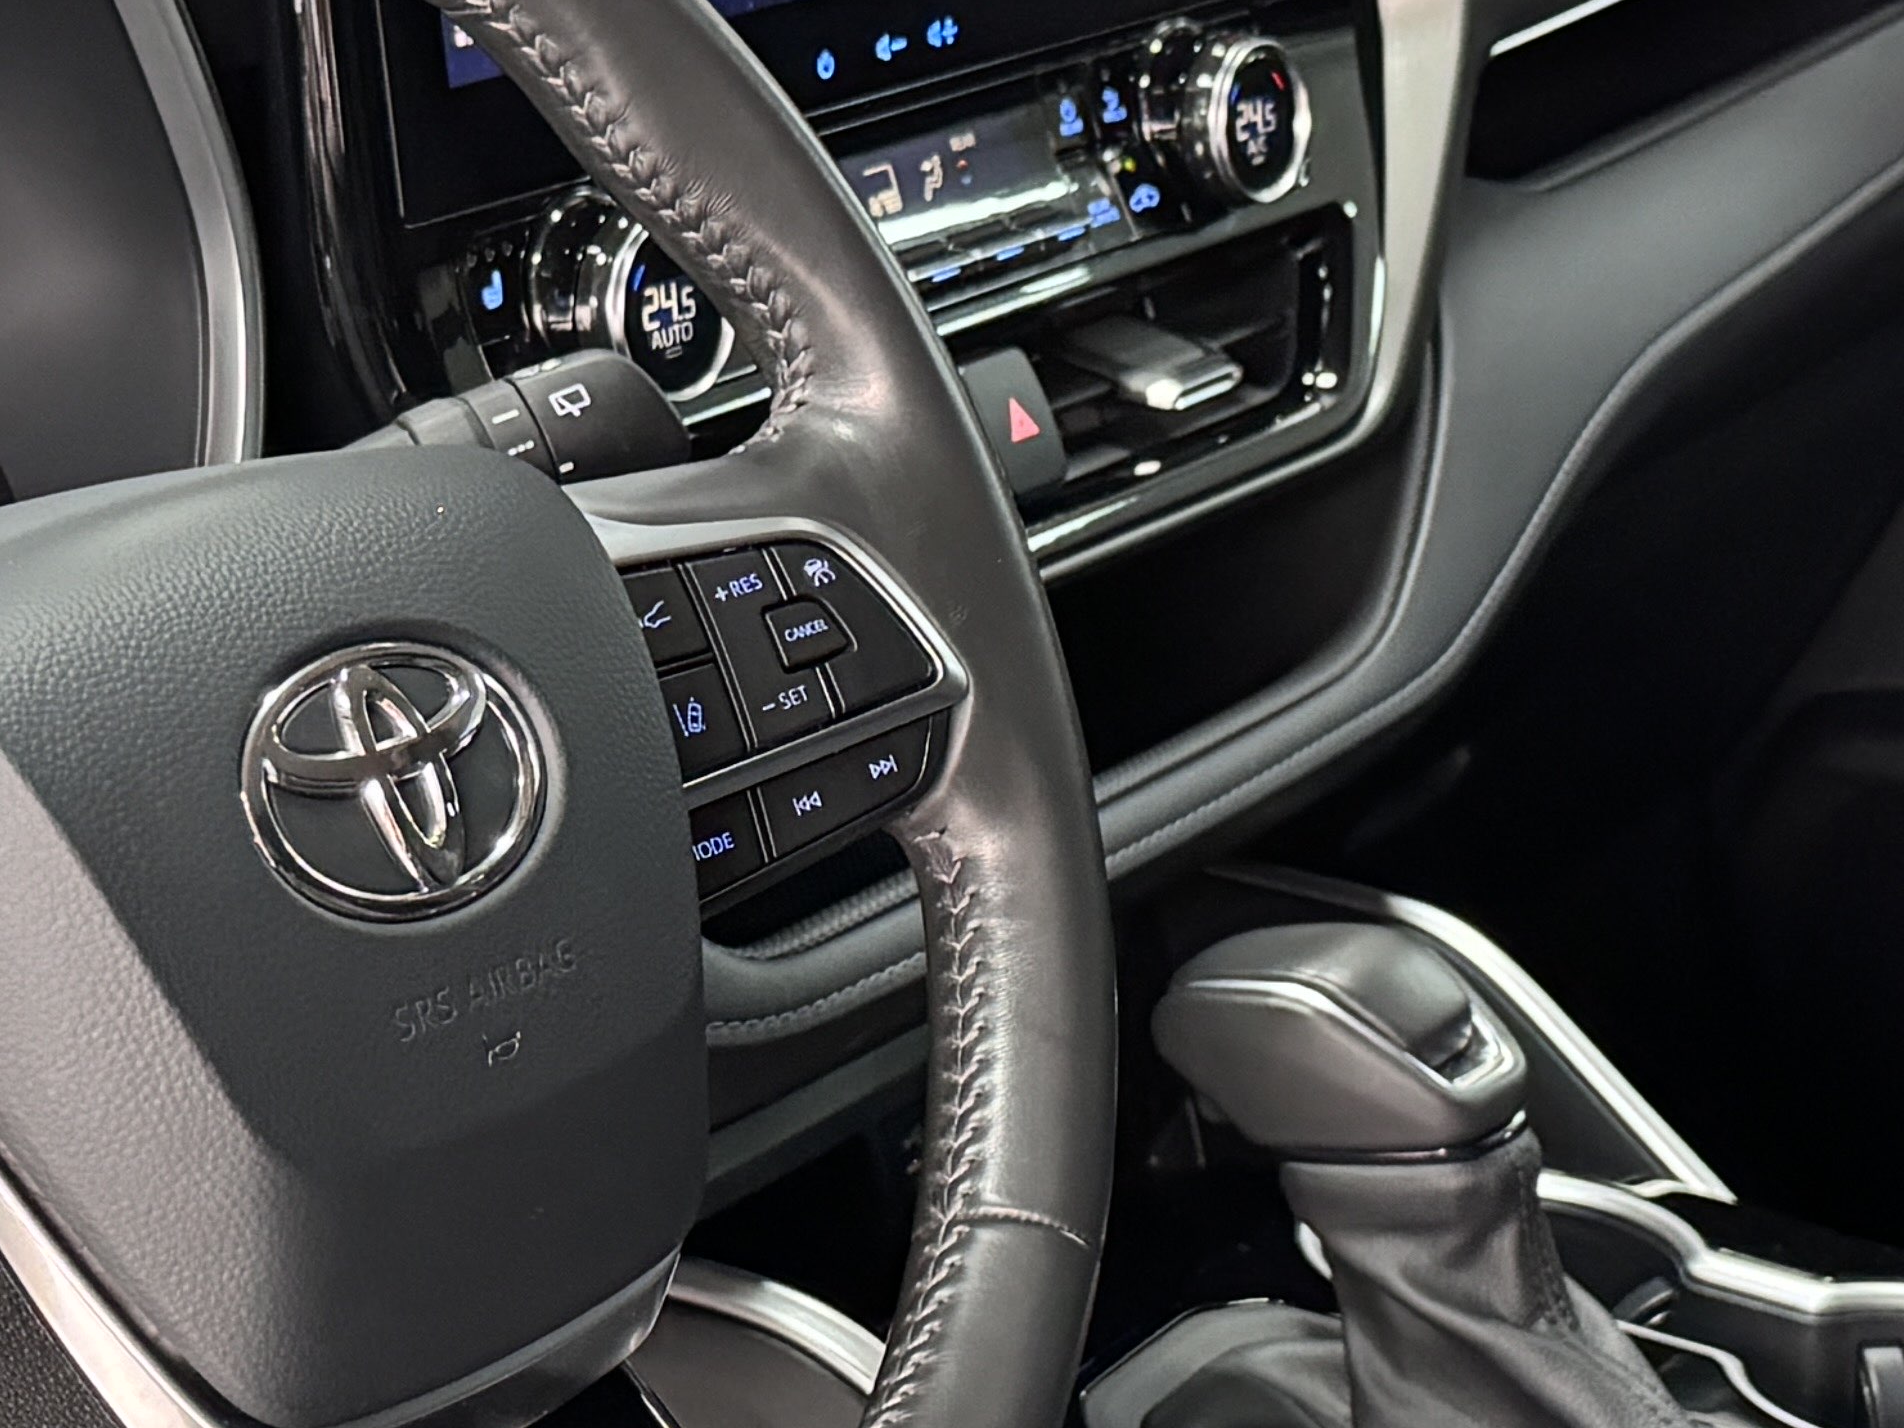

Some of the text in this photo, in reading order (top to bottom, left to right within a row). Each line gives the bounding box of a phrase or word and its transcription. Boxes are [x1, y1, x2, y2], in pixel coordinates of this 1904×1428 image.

[641, 282, 697, 332] 24.5
[652, 321, 694, 350] AUTO
[784, 619, 829, 642] CANCEL
[778, 684, 808, 710] SET
[692, 832, 735, 861] ODE
[395, 938, 578, 1043] SRS AIRBAG
